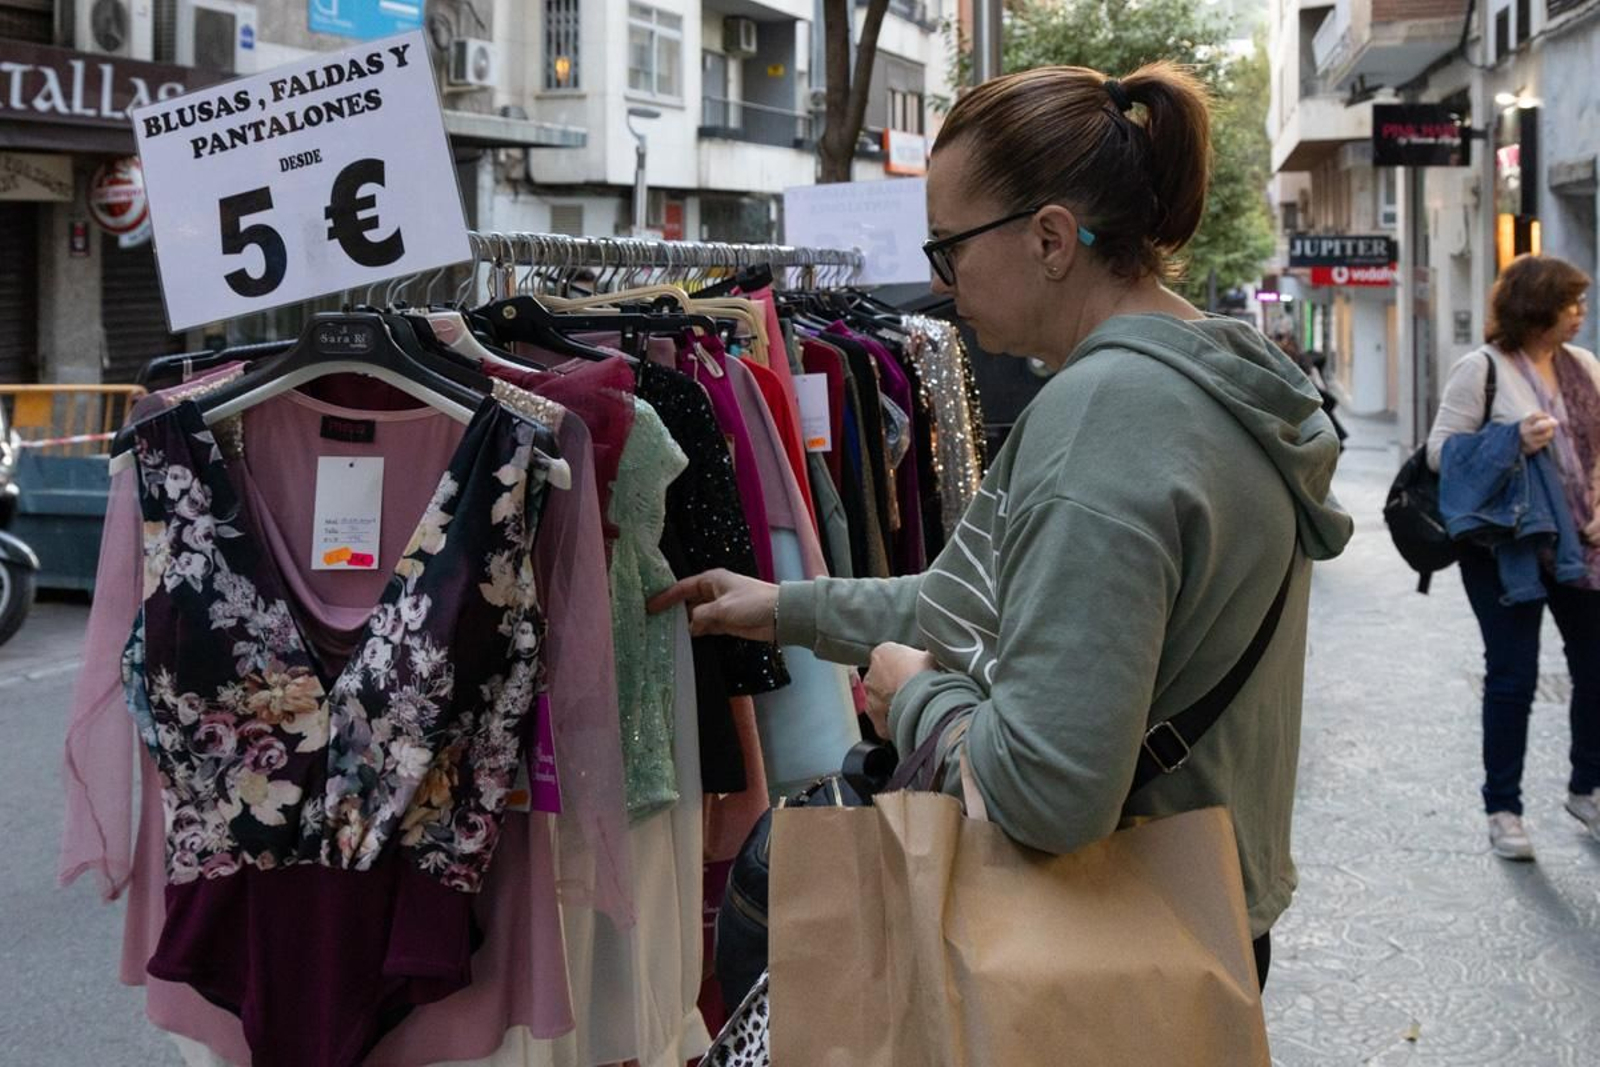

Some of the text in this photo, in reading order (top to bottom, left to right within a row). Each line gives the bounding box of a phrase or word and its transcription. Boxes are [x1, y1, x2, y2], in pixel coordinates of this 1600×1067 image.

[143, 90, 250, 138] BLUSAS
[269, 52, 385, 102] FALDAS
[388, 44, 410, 68] Y
[190, 88, 383, 159] PANTALONES
[279, 148, 323, 173] DESDE
[218, 158, 405, 298] 5 €
[1290, 238, 1388, 257] JUPITER
